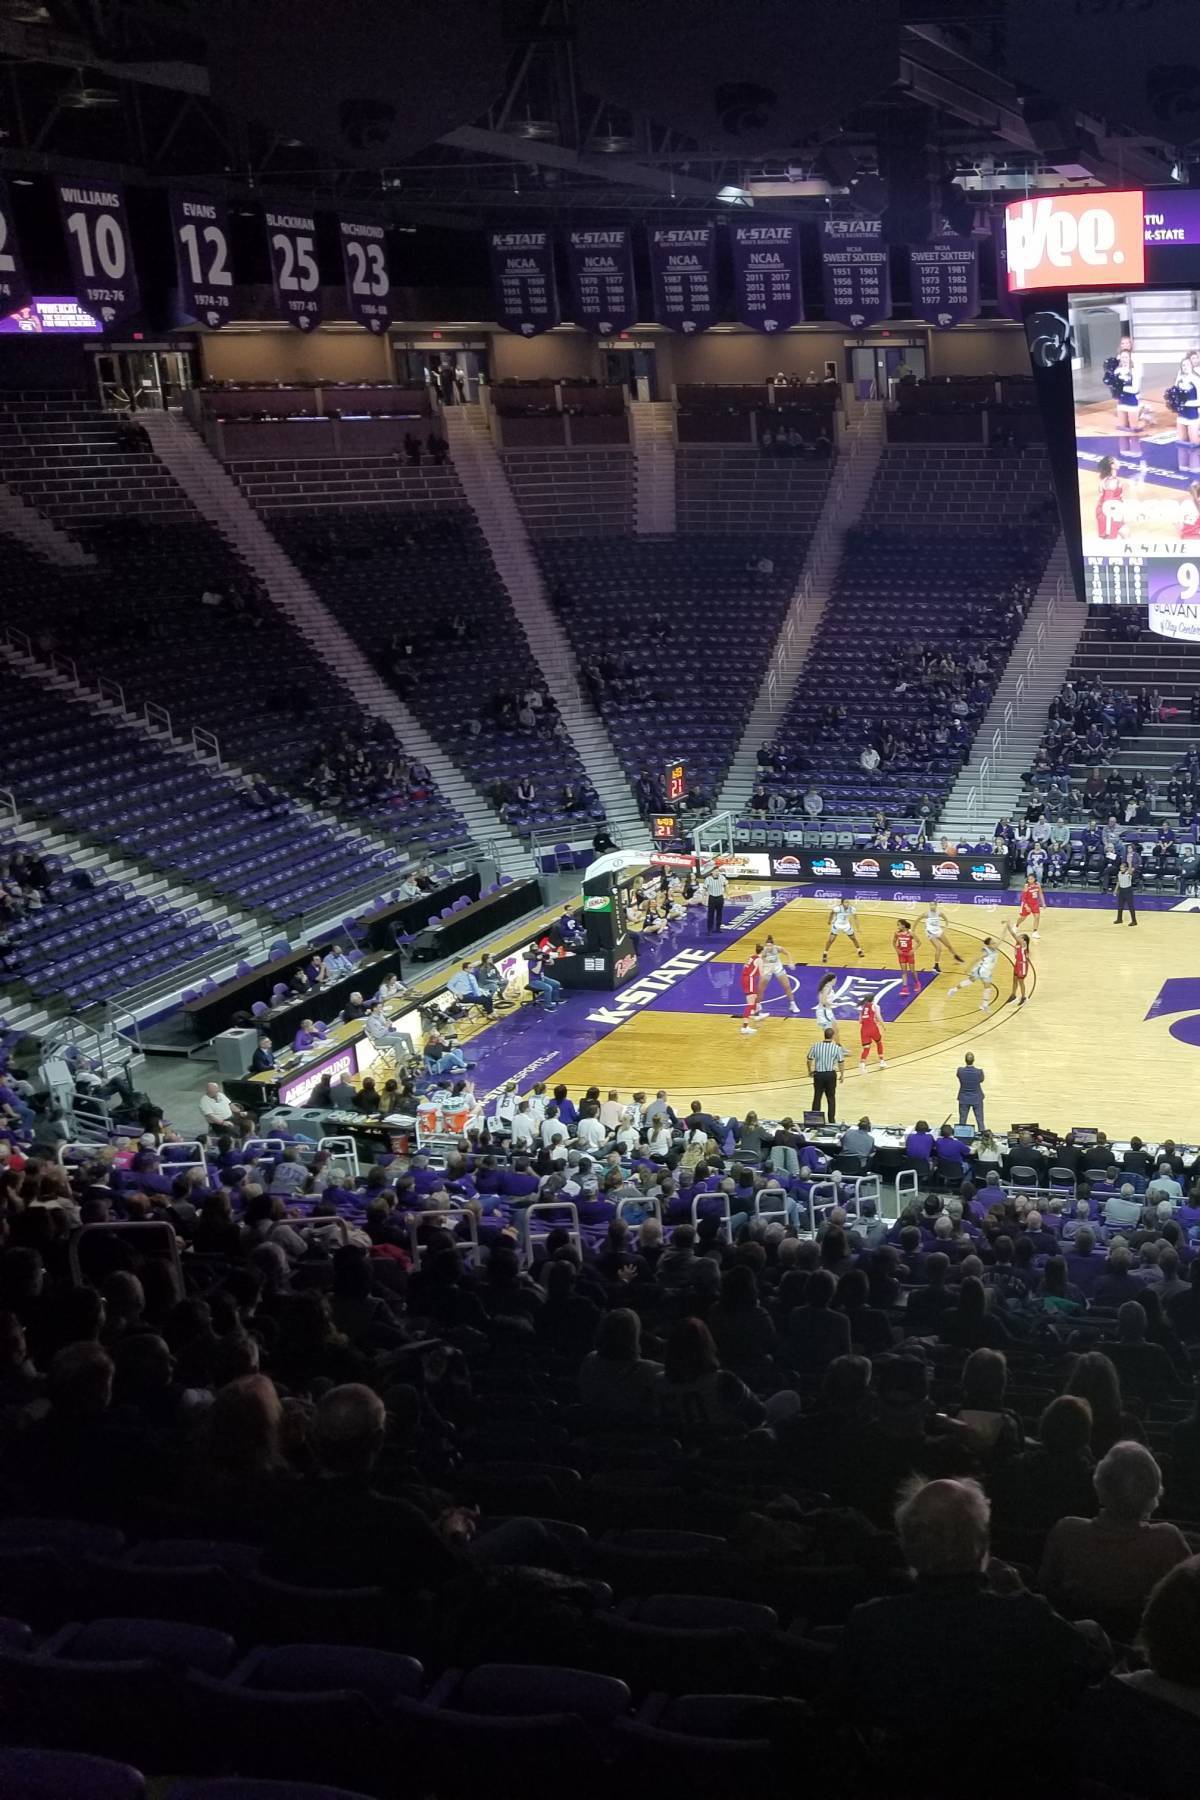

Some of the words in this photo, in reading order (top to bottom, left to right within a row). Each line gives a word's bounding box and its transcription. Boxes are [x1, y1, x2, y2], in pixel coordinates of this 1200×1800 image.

[60, 187, 120, 207] WILLIAMS
[182, 202, 216, 219] EVANS
[265, 213, 315, 231] BLACKMAN
[1144, 214, 1164, 225] TTU
[340, 221, 385, 239] RICHMOND
[824, 220, 882, 233] K-STATE
[492, 233, 546, 246] K-STATE
[570, 231, 624, 244] K-STATE
[654, 229, 710, 242] K-STATE
[736, 227, 792, 240] K-STATE
[1144, 229, 1184, 240] K-STATE
[67, 212, 126, 279] 10
[179, 224, 233, 286] 12
[584, 256, 615, 267] NCAA
[668, 255, 699, 265] NCAA
[750, 253, 781, 263] NCAA
[823, 253, 852, 262] SWEET
[852, 252, 887, 261] SIXTEEN
[911, 252, 940, 261] SWEET
[940, 251, 975, 260] SIXTEEN
[271, 233, 320, 292] 25
[346, 241, 390, 297] 23
[506, 258, 537, 268] NCAA
[859, 267, 878, 275] 1961
[860, 277, 879, 285] 1964
[87, 288, 125, 302] 1972-76
[921, 286, 940, 294] 1975
[747, 302, 767, 311] 2014
[922, 296, 940, 304] 1977
[1177, 562, 1200, 600] 9
[657, 827, 671, 836] 21
[584, 948, 717, 1025] K-STATE
